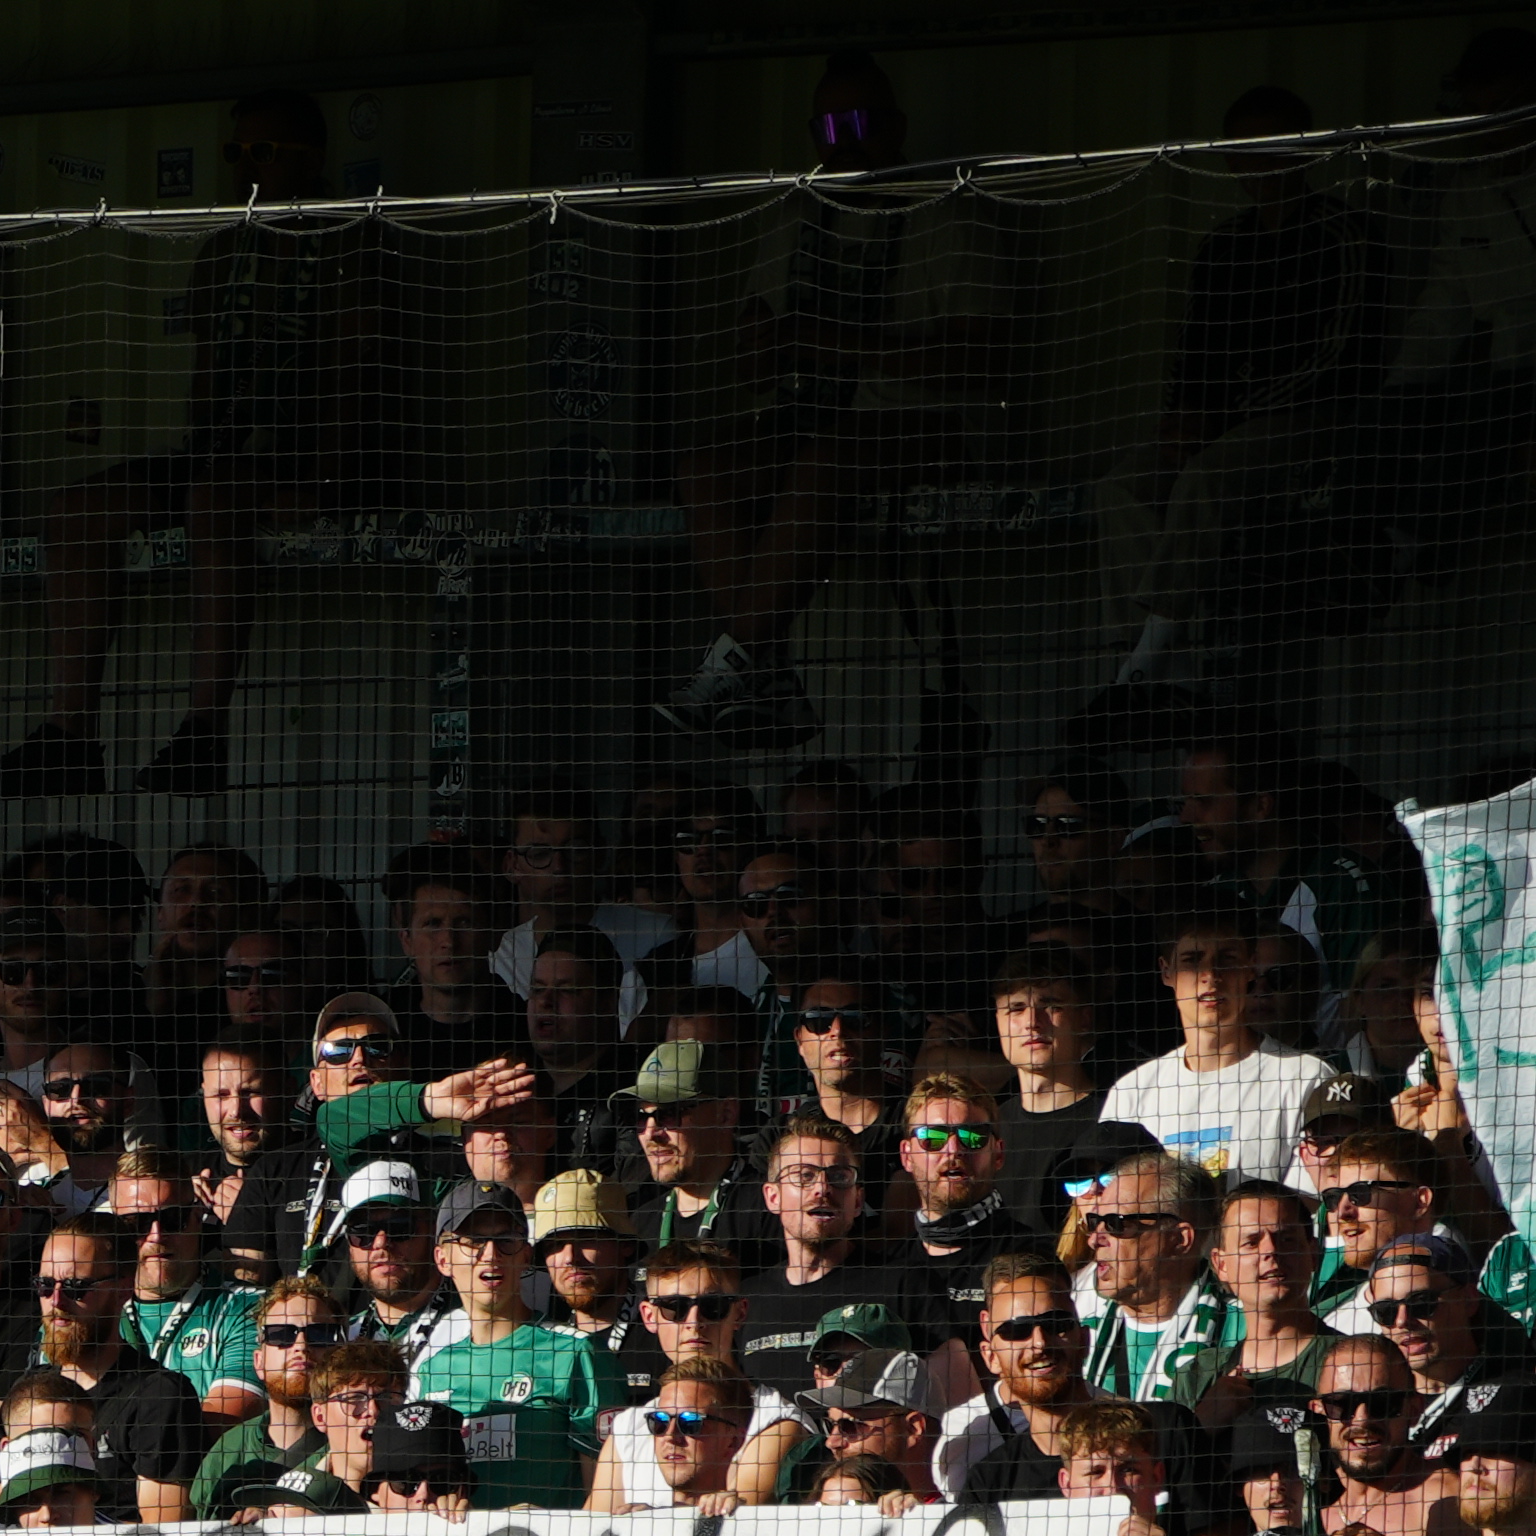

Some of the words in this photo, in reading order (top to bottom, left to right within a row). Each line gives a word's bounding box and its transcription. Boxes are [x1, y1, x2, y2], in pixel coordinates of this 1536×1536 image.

[578, 132, 632, 148] HSV
[1325, 1081, 1353, 1102] NY
[502, 1381, 529, 1401] VfB
[467, 1438, 514, 1461] eBelt
